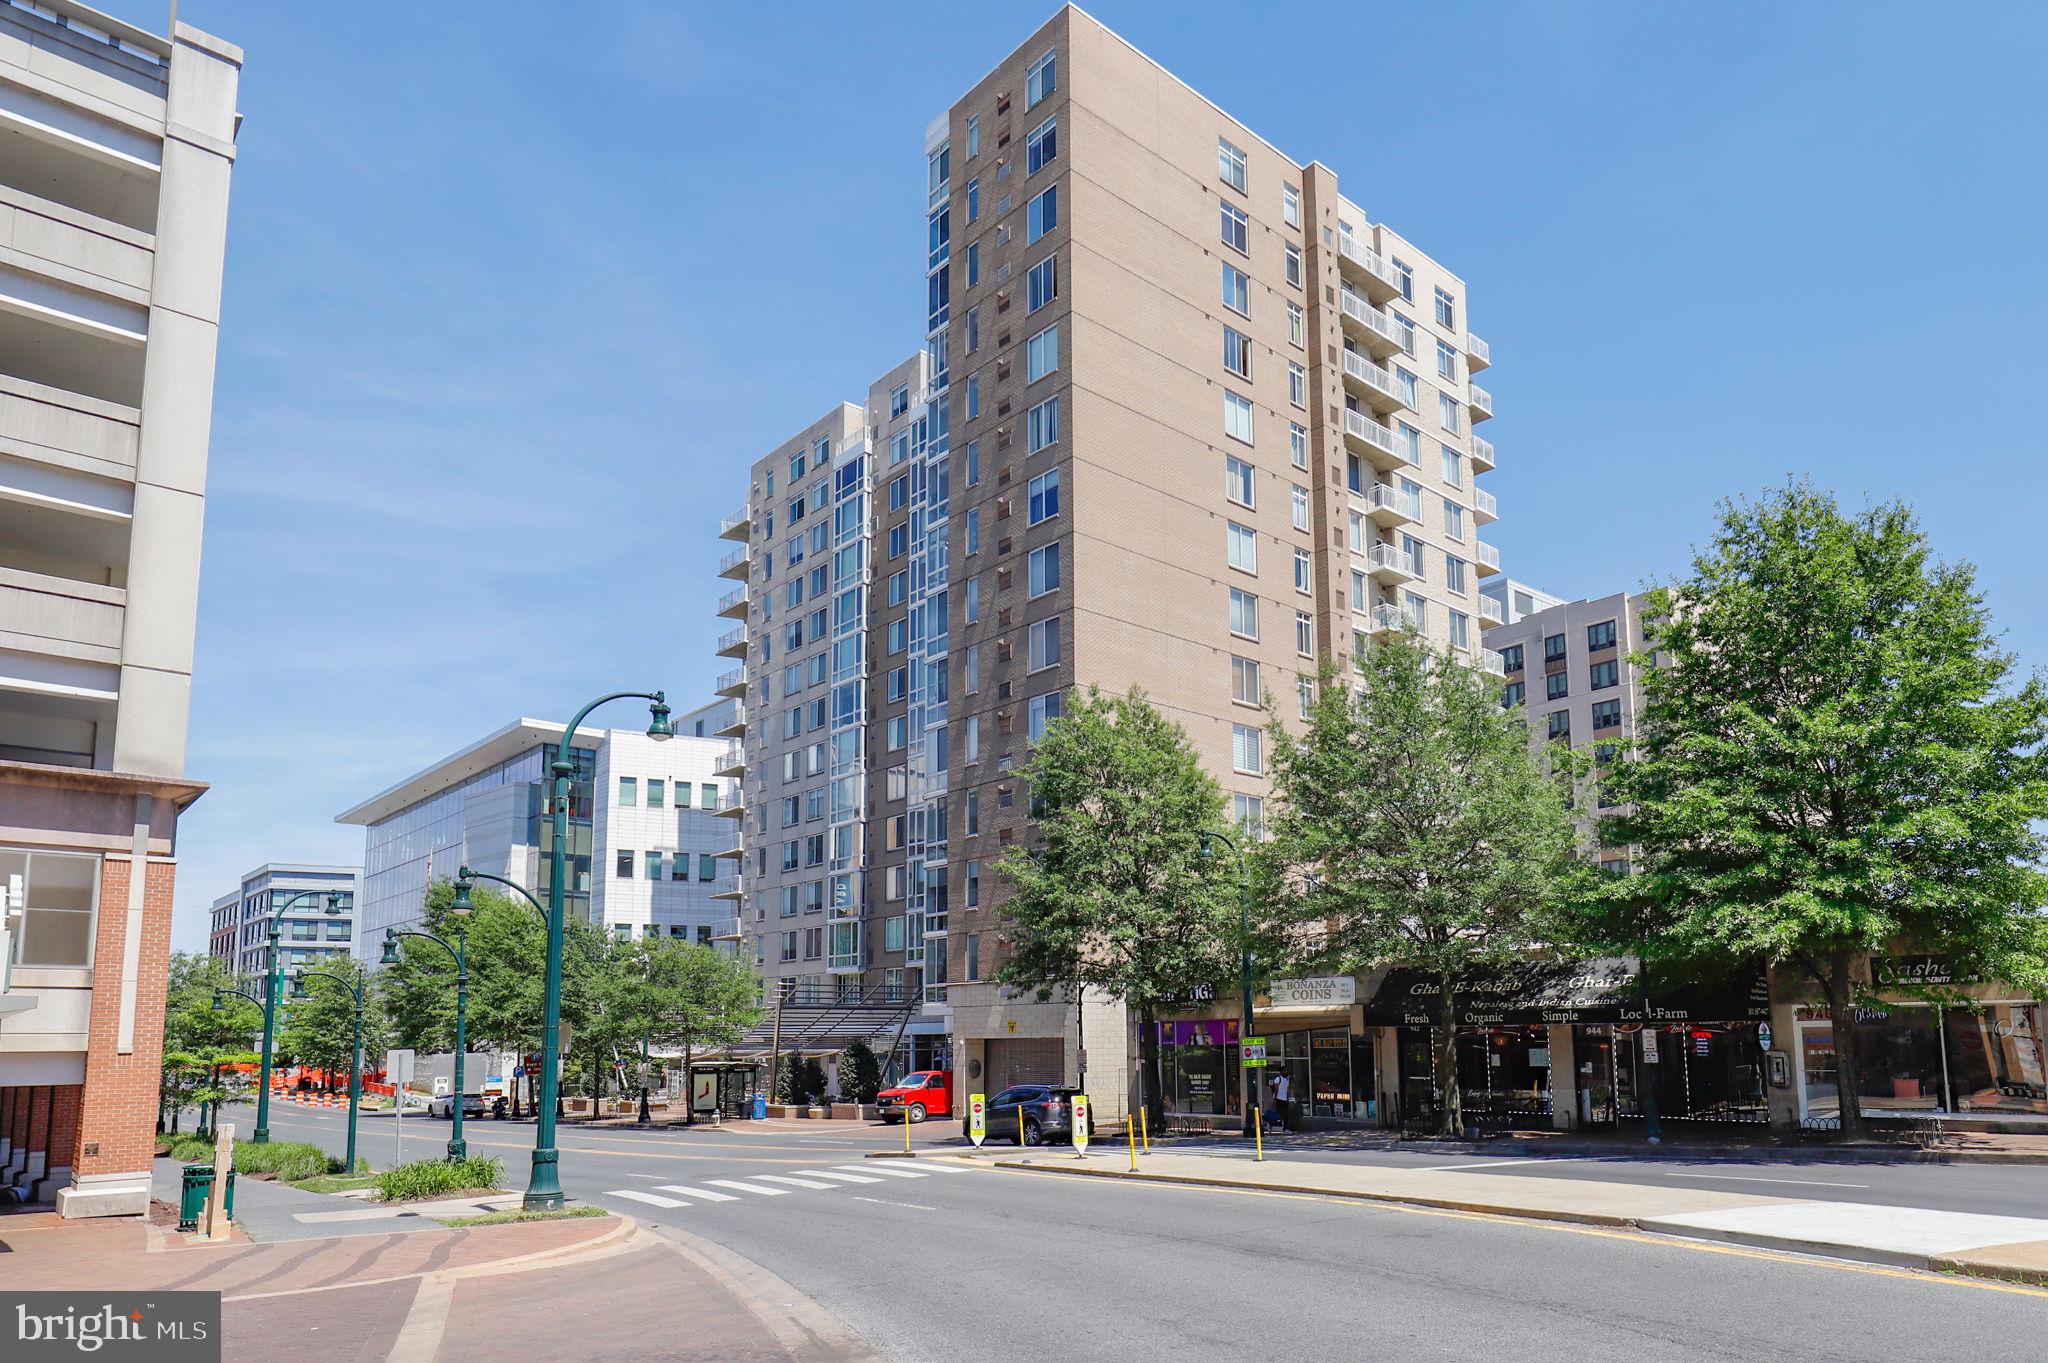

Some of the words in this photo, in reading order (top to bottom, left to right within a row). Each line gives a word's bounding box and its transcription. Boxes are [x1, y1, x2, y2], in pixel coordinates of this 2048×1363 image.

[1286, 980, 1337, 990] BONANZA
[1292, 989, 1332, 1000] COINS
[1575, 997, 1617, 1006] Cuisine
[1404, 1013, 1430, 1024] Fresh
[1465, 1012, 1504, 1025] Organic
[1542, 1010, 1579, 1023] Simple
[1620, 1007, 1688, 1019] Locl-Farm
[1586, 1027, 1602, 1035] 944
